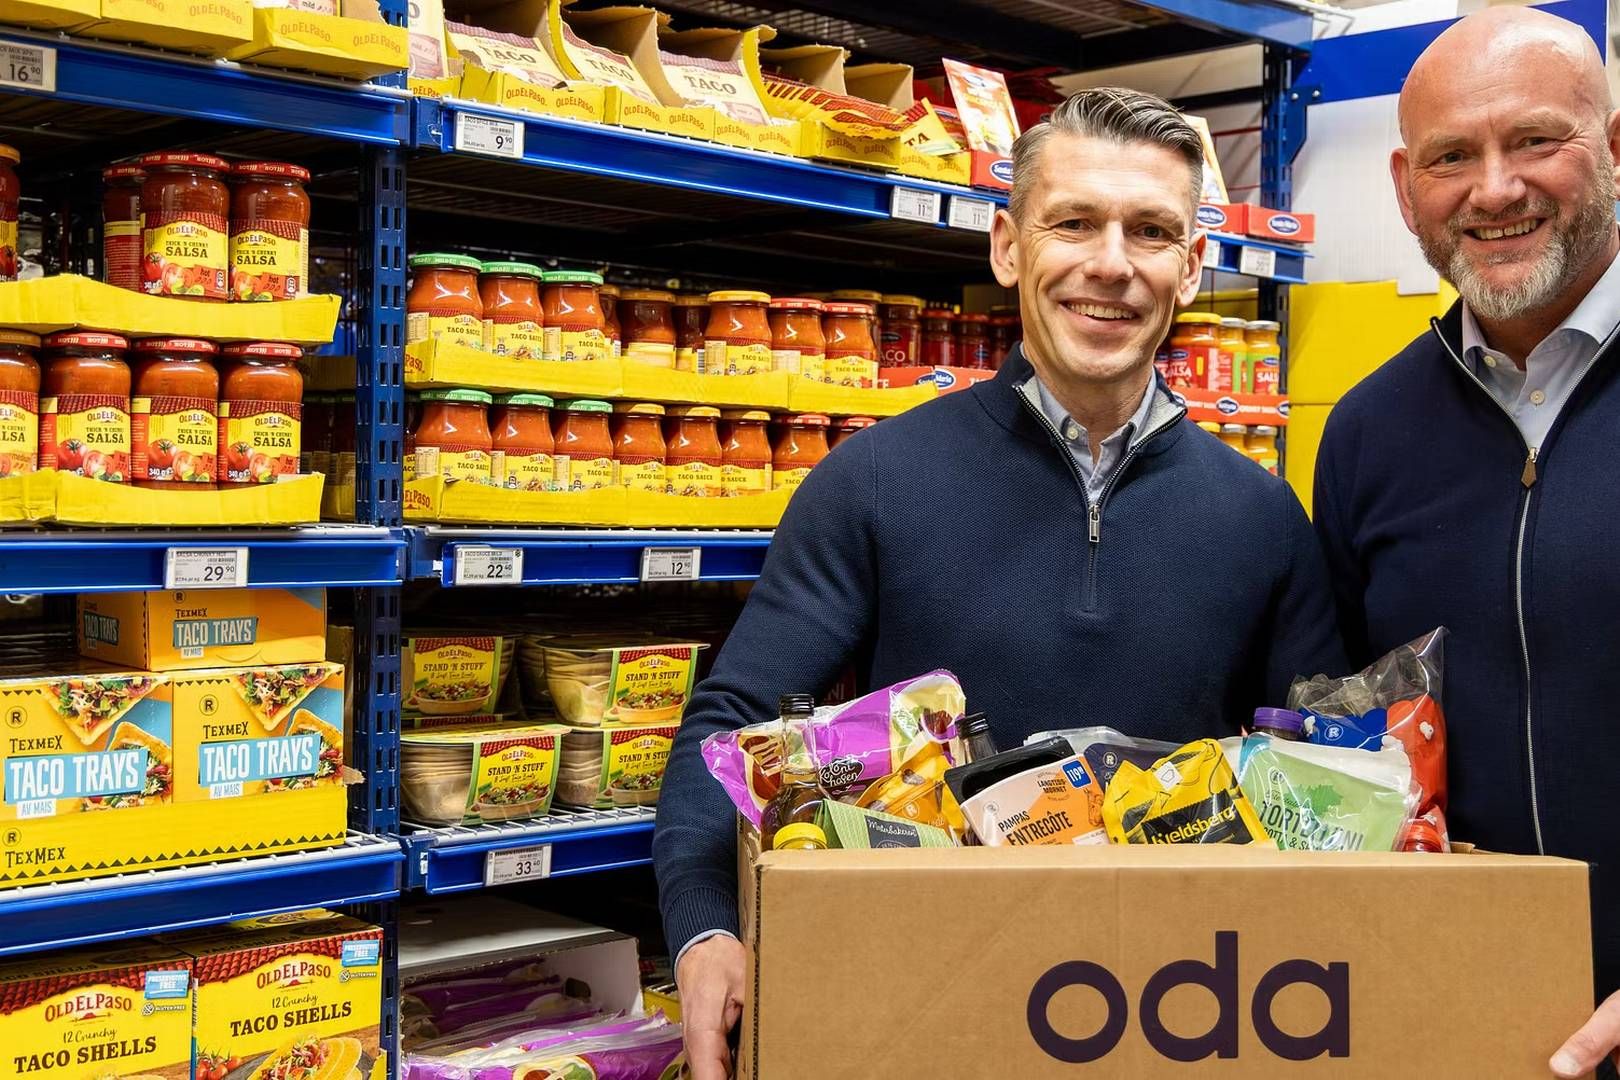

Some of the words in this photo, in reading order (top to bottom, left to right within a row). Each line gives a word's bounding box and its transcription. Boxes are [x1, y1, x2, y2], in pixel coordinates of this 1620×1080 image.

[479, 46, 536, 63] TACO
[10, 63, 28, 81] 16
[586, 59, 635, 82] TACO
[684, 75, 736, 95] TACO
[495, 135, 504, 149] 9
[165, 246, 208, 258] SALSA
[237, 255, 277, 265] SALSA
[200, 267, 210, 277] hot
[87, 433, 124, 444] SALSA
[177, 434, 213, 446] SALSA
[253, 436, 292, 448] SALSA
[204, 566, 224, 581] 29
[225, 565, 235, 573] 90
[487, 564, 503, 578] 22
[671, 562, 683, 575] 12
[176, 622, 209, 647] TACO
[212, 619, 252, 644] TRAYS
[423, 663, 448, 672] STAND
[460, 662, 484, 671] STUFF
[625, 672, 649, 682] STAND
[659, 671, 681, 680] STUFF
[203, 743, 250, 783] TACO
[256, 736, 313, 776] TRAYS
[619, 755, 642, 763] STAND
[10, 758, 64, 801] TACO
[72, 751, 140, 793] TRAYS
[487, 767, 511, 777] STAND
[523, 762, 545, 773] STUFF
[1066, 768, 1082, 782] 119
[213, 785, 222, 797] AV
[223, 783, 240, 796] MAIS
[20, 803, 32, 816] AV
[33, 800, 53, 814] MAIS
[998, 811, 1031, 833] PAMPAS
[1006, 810, 1073, 846] ENTRECÔTE
[515, 861, 532, 876] 33
[272, 997, 281, 1008] 12
[282, 993, 318, 1008] Crunchy
[1027, 930, 1350, 1064] oda
[230, 1014, 278, 1037] TACO
[283, 1001, 352, 1028] SHELLS
[63, 1031, 73, 1043] 12
[75, 1027, 117, 1043] Crunchy
[14, 1049, 70, 1073] TACO
[77, 1035, 157, 1065] SHELLS
